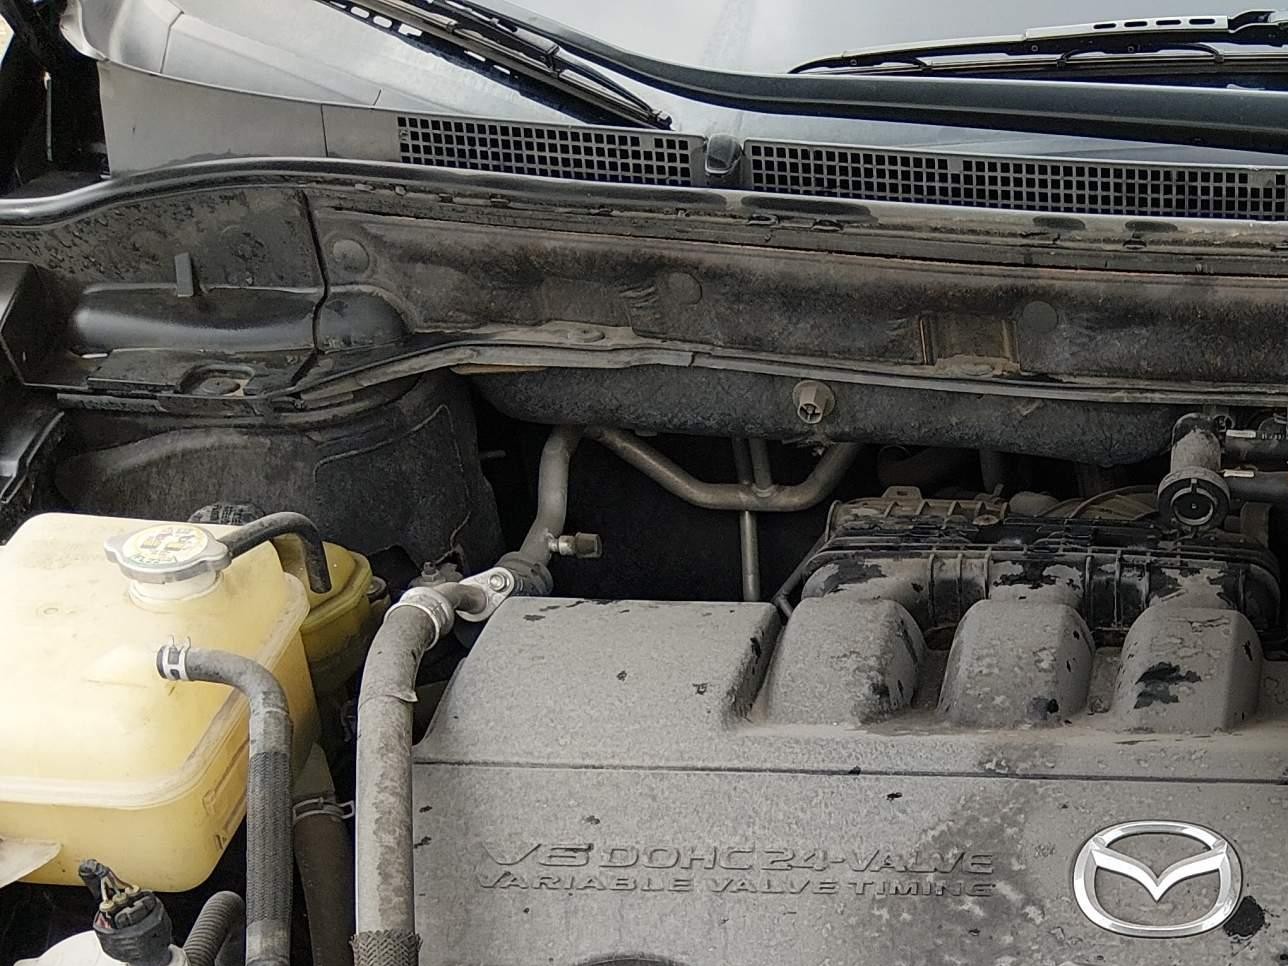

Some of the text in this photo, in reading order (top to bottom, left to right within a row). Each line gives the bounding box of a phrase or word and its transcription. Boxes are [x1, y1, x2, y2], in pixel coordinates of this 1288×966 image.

[481, 843, 994, 874] V6 DOHC 24-VALVE
[477, 871, 995, 897] VARIABLE VALVE TIMING
